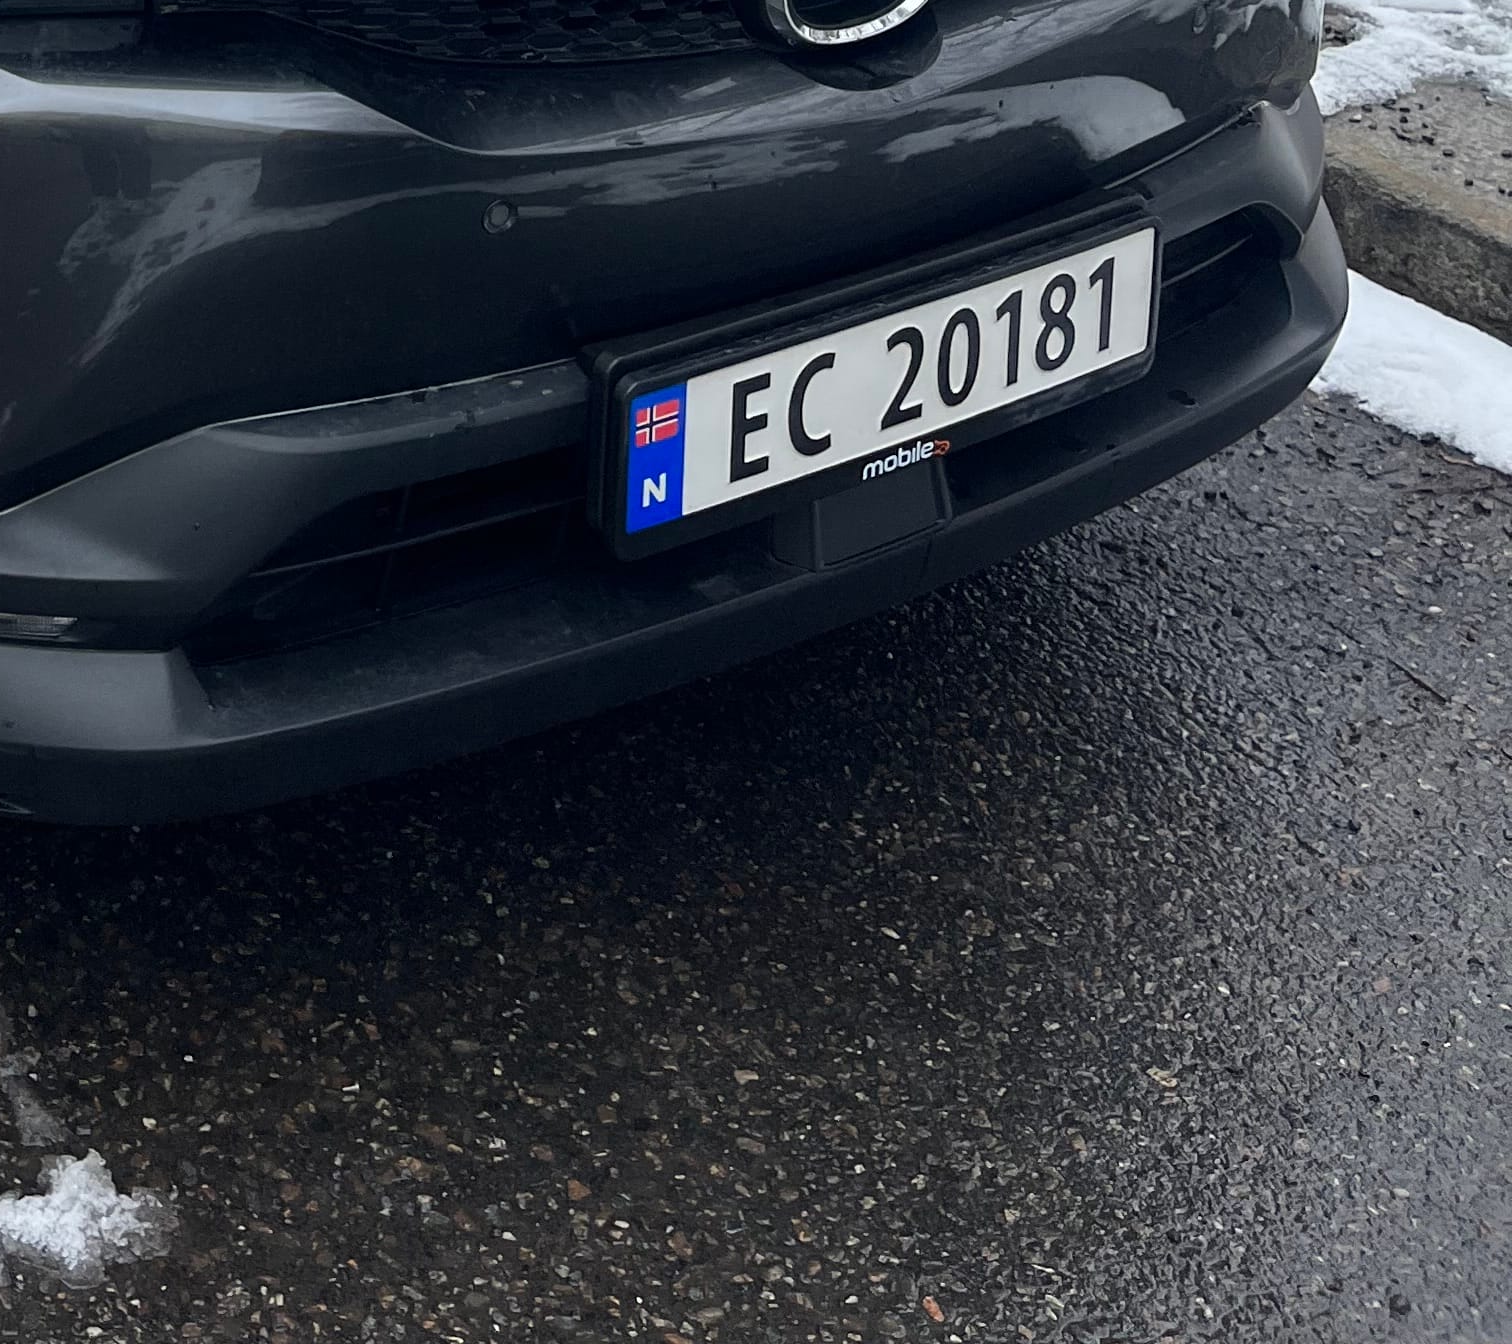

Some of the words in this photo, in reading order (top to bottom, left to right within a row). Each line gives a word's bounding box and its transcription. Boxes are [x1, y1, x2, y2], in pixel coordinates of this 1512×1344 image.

[729, 353, 836, 483] EC
[879, 256, 1116, 431] 20181
[641, 472, 667, 508] N
